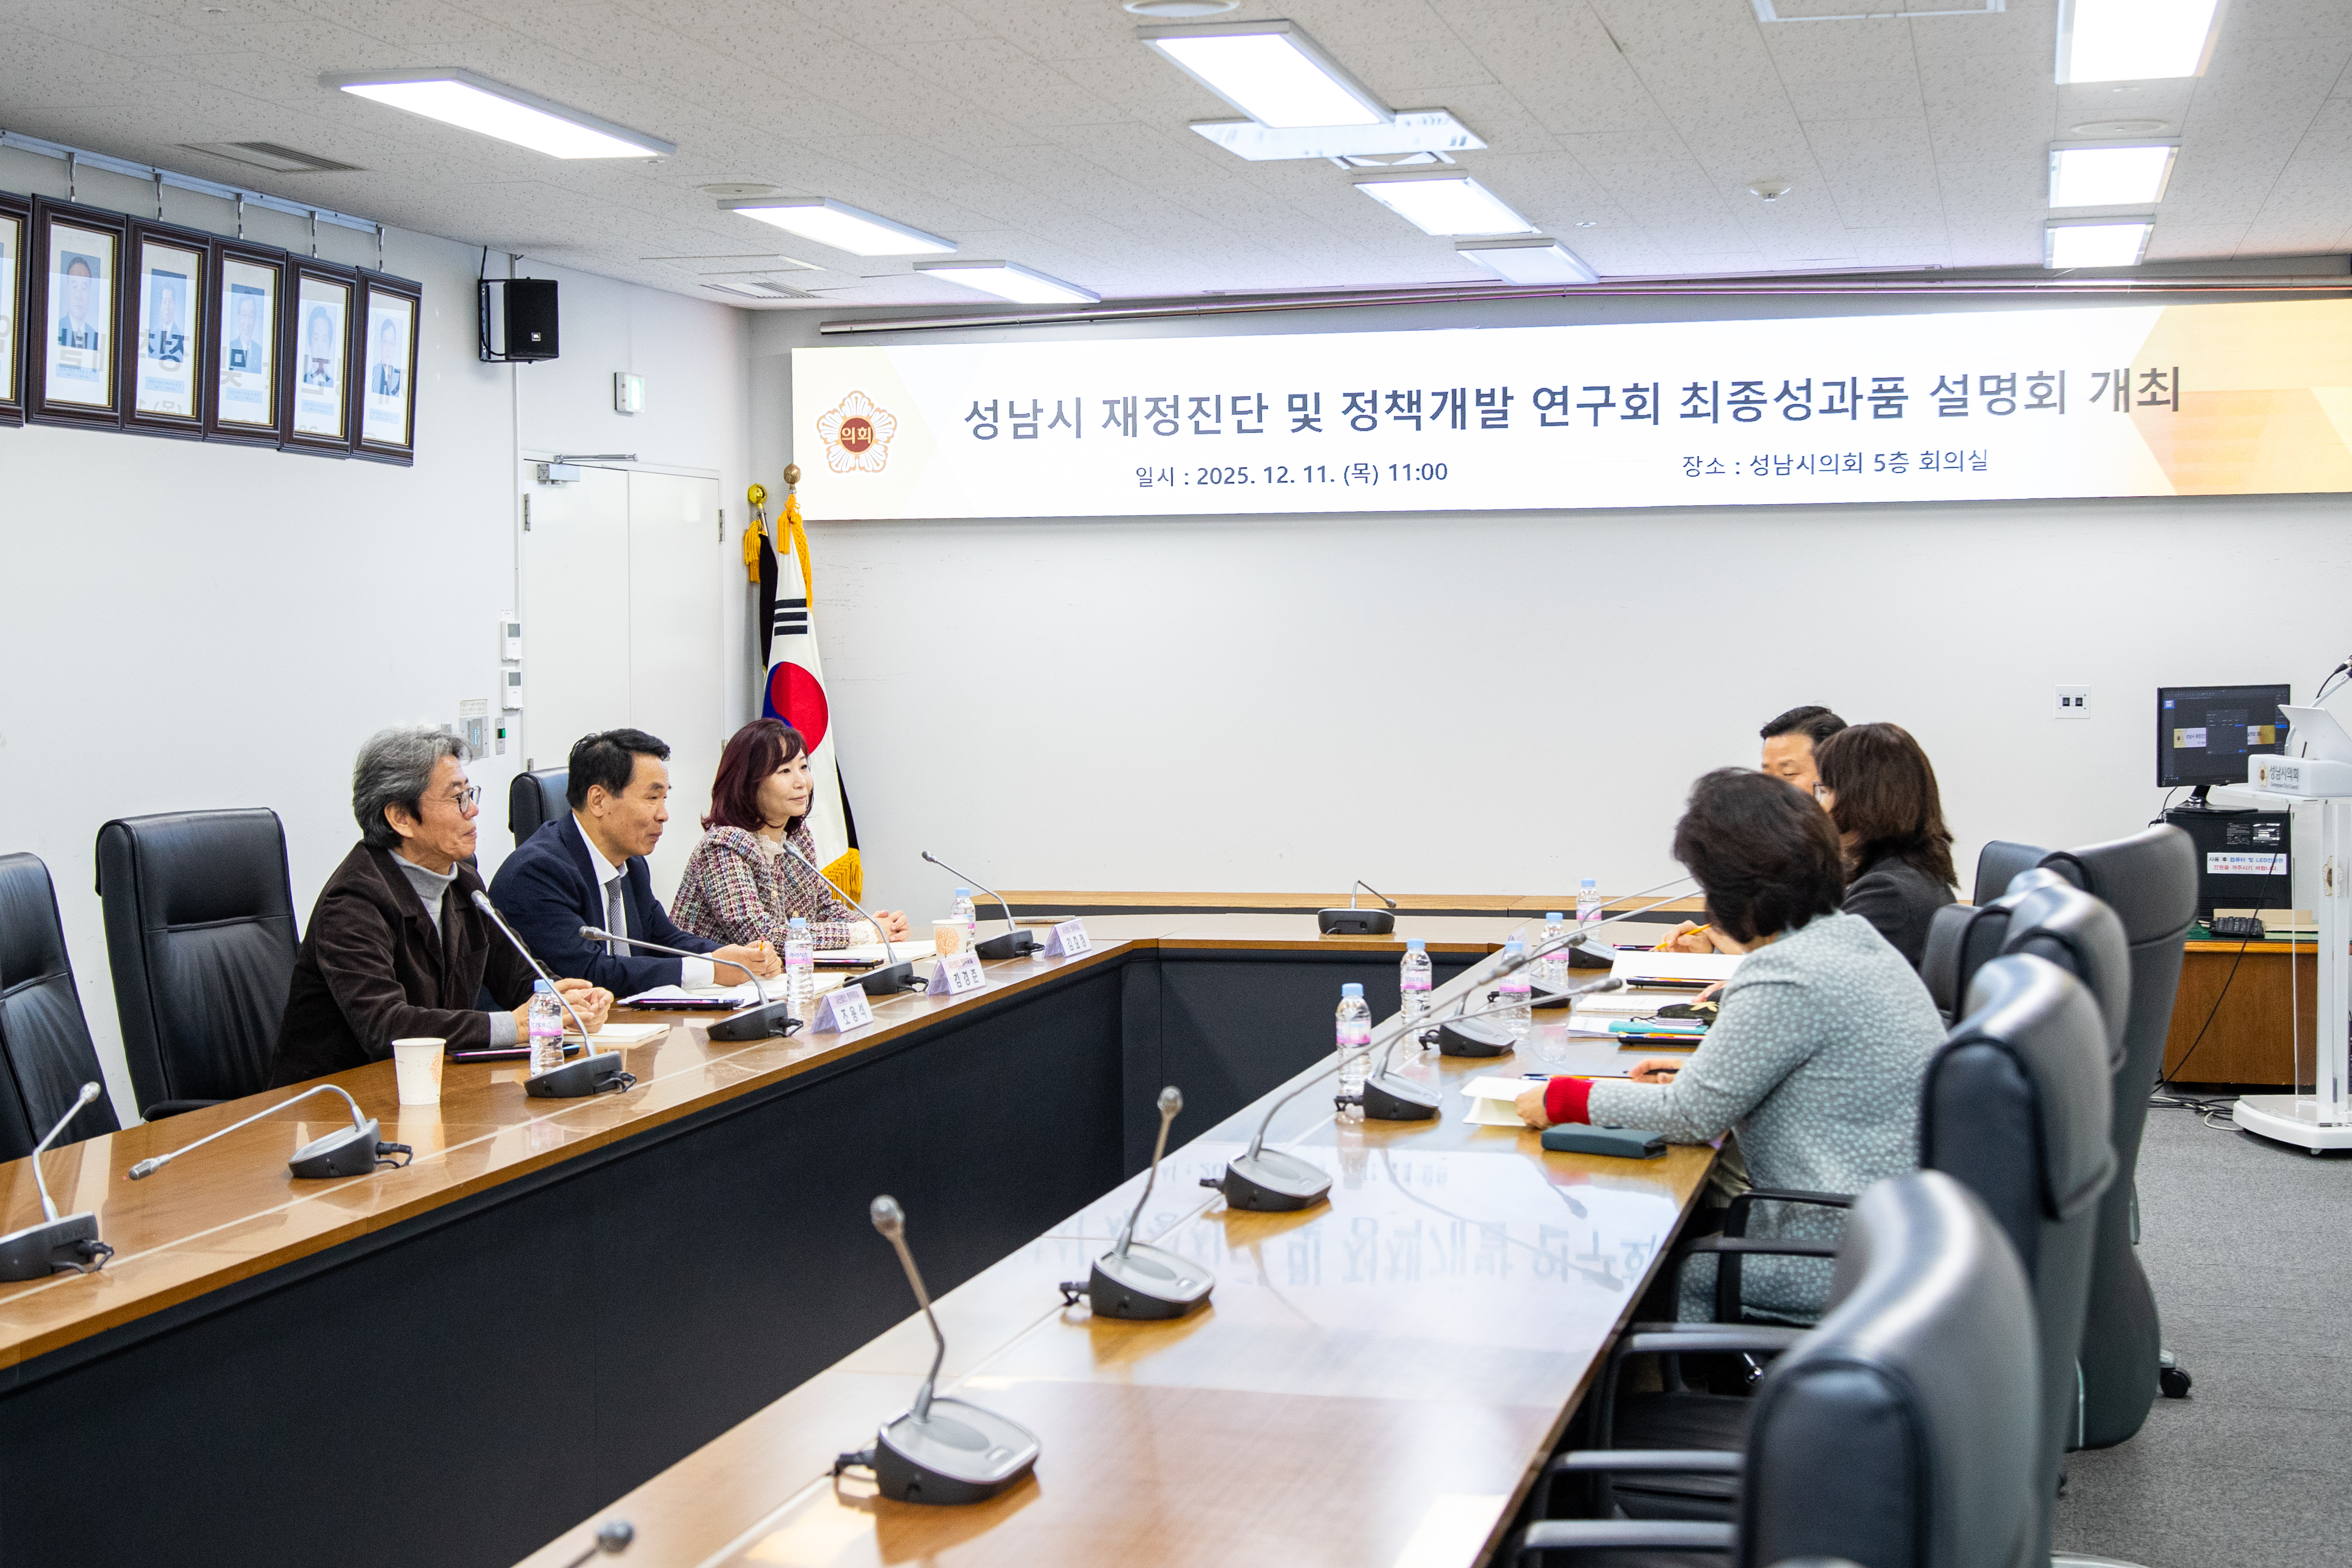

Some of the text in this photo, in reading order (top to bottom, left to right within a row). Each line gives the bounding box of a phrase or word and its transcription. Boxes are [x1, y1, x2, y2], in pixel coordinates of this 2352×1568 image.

[964, 367, 2179, 440] 성남시 재정진단 및 정책개발 연구회 최종성과품 설명회 개최
[841, 427, 871, 444] 의회
[1683, 456, 1725, 477] 장소
[1750, 452, 1863, 476] 성남시의회
[1874, 451, 1909, 474] 5층
[1919, 449, 1987, 472] 회의실
[1136, 467, 1174, 487] 일시
[1197, 466, 1255, 485] 2025.
[1264, 466, 1295, 484] 12.
[1303, 465, 1335, 483] 11.
[1344, 463, 1378, 486] (목)
[1389, 463, 1447, 481] 11:00
[2269, 766, 2298, 782] 성남시의회
[954, 969, 979, 988] 김경준
[841, 1003, 867, 1025] 조용석
